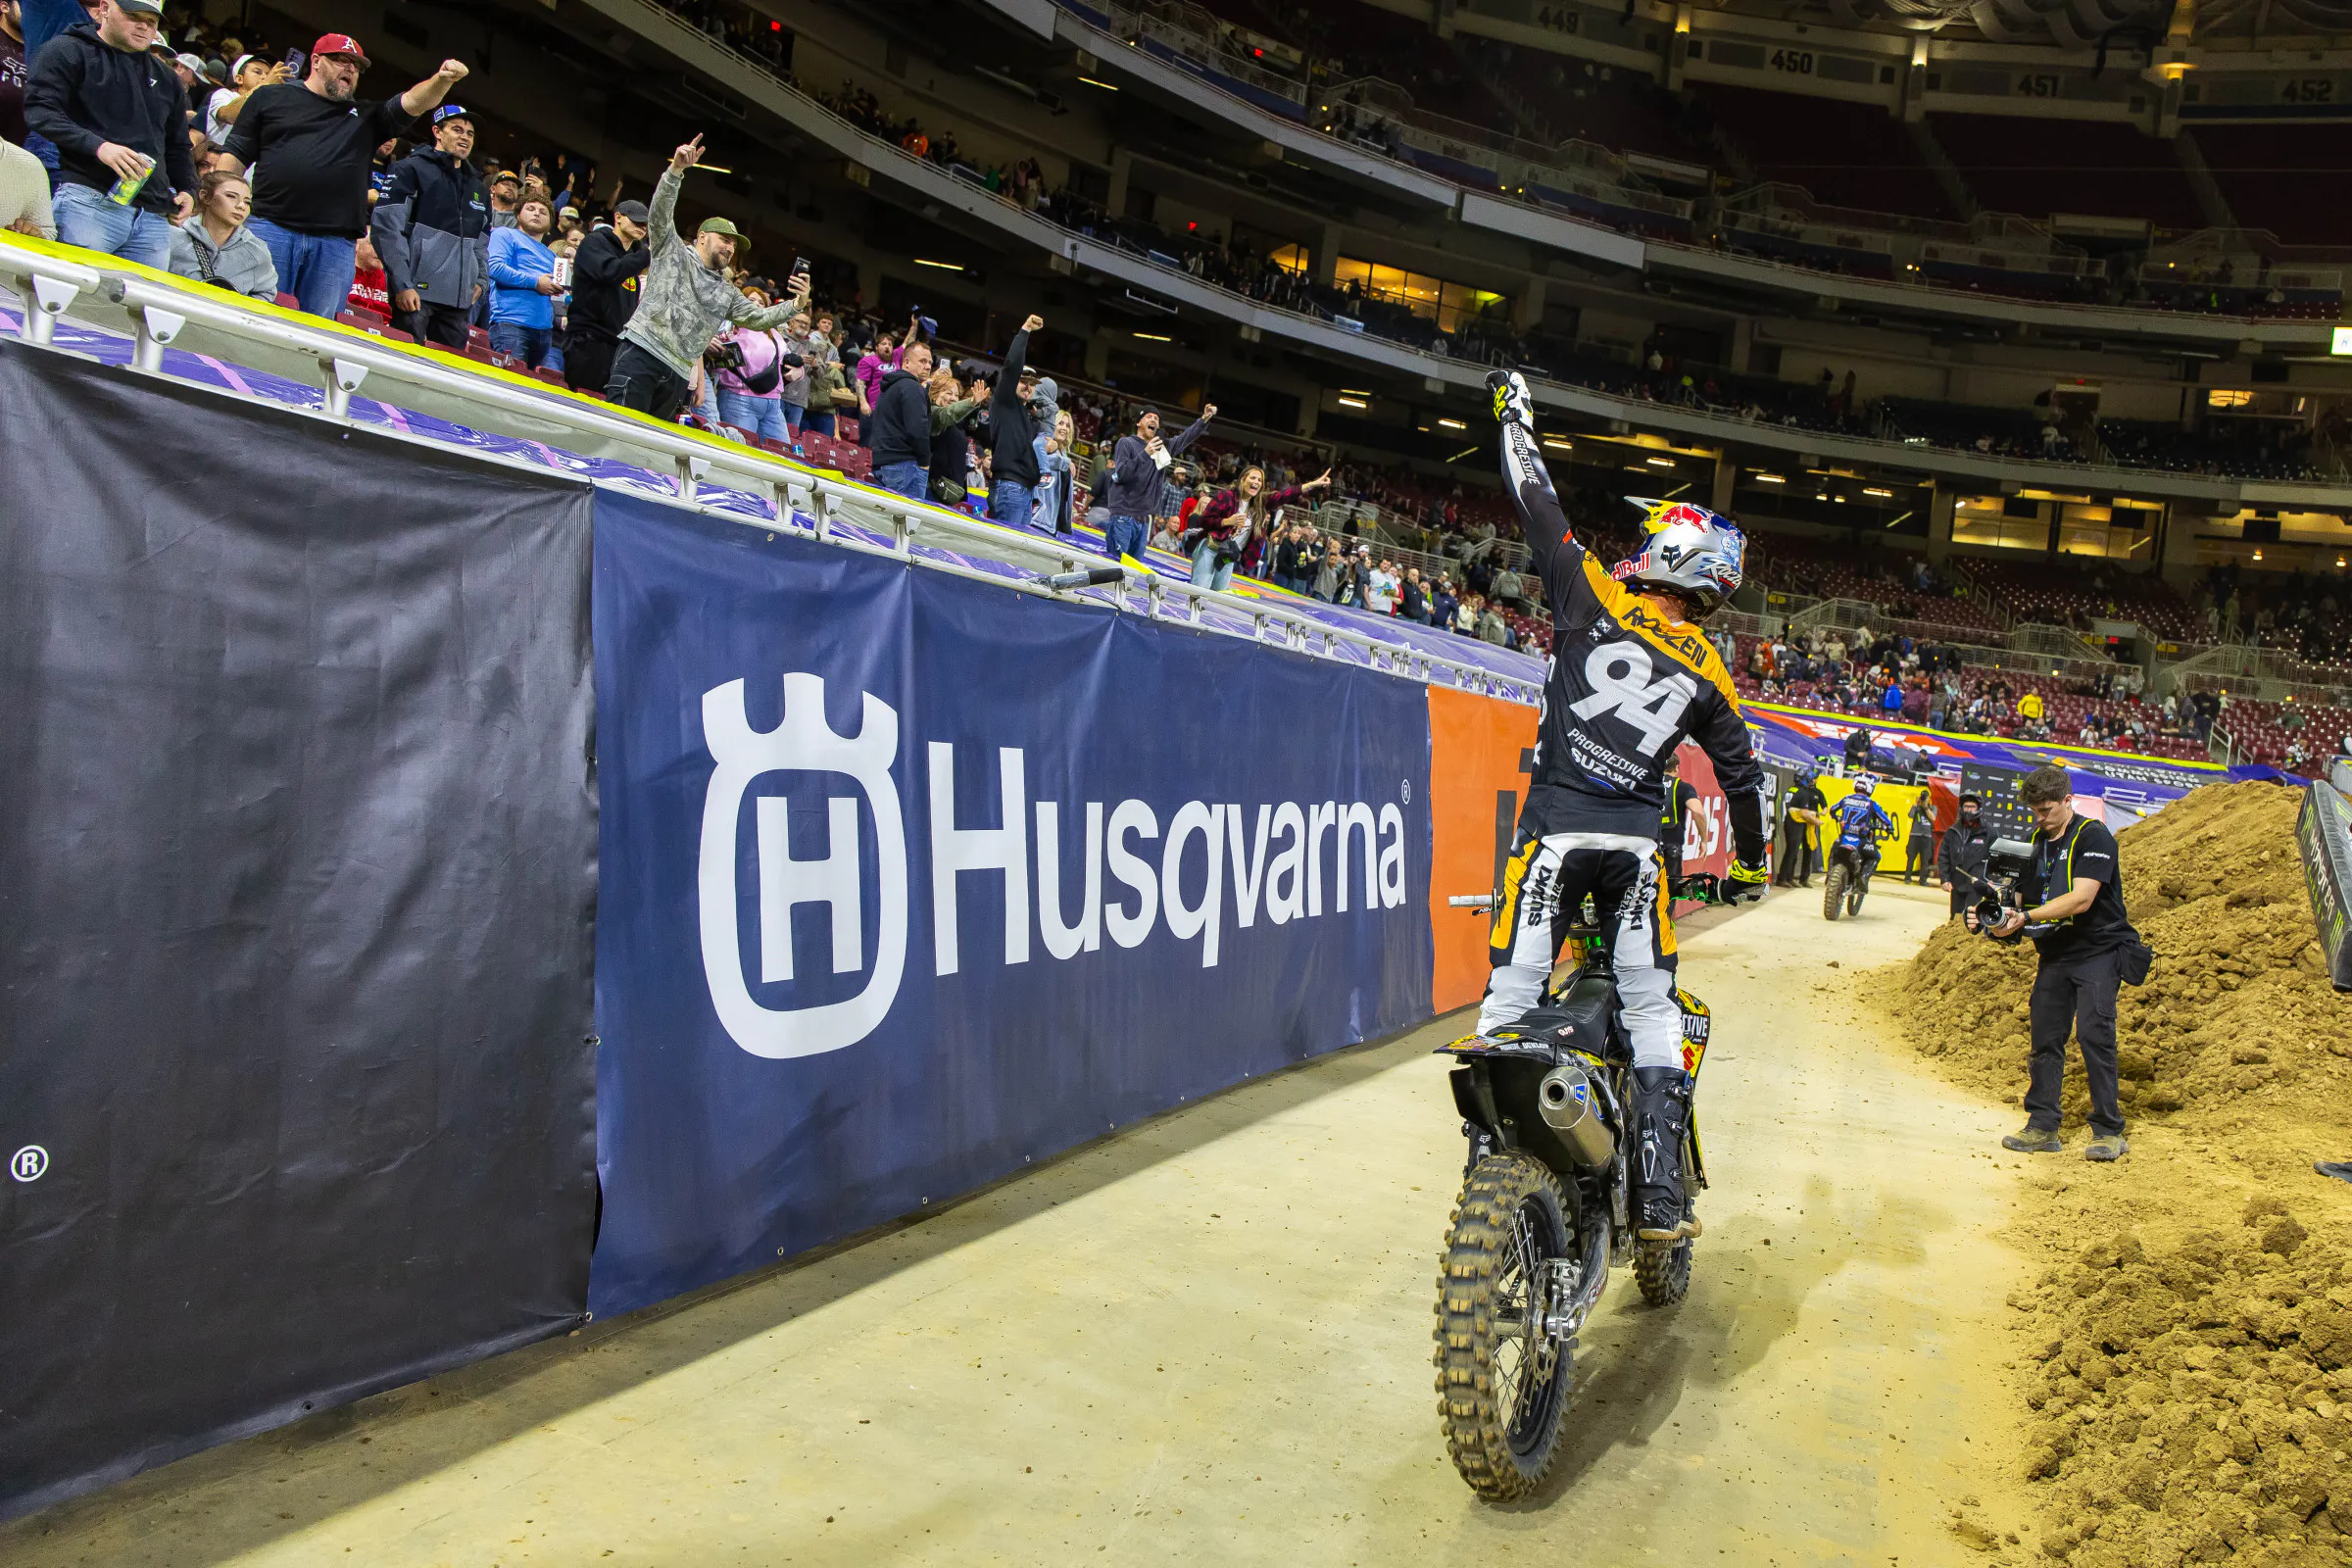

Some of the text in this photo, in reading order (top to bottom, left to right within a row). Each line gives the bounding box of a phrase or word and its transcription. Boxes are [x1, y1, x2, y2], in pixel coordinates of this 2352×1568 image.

[342, 36, 358, 54] A
[1771, 49, 1813, 74] 450
[1, 70, 27, 88] FO
[2018, 73, 2059, 97] 451
[2280, 78, 2333, 102] 452
[1509, 421, 1541, 485] PROGRESSIVE
[1623, 552, 1650, 577] Bull
[1568, 640, 1698, 759] 94
[1567, 727, 1649, 782] PROGRESSIVE
[1570, 747, 1637, 791] SUZUKI
[1842, 805, 1869, 825] 17
